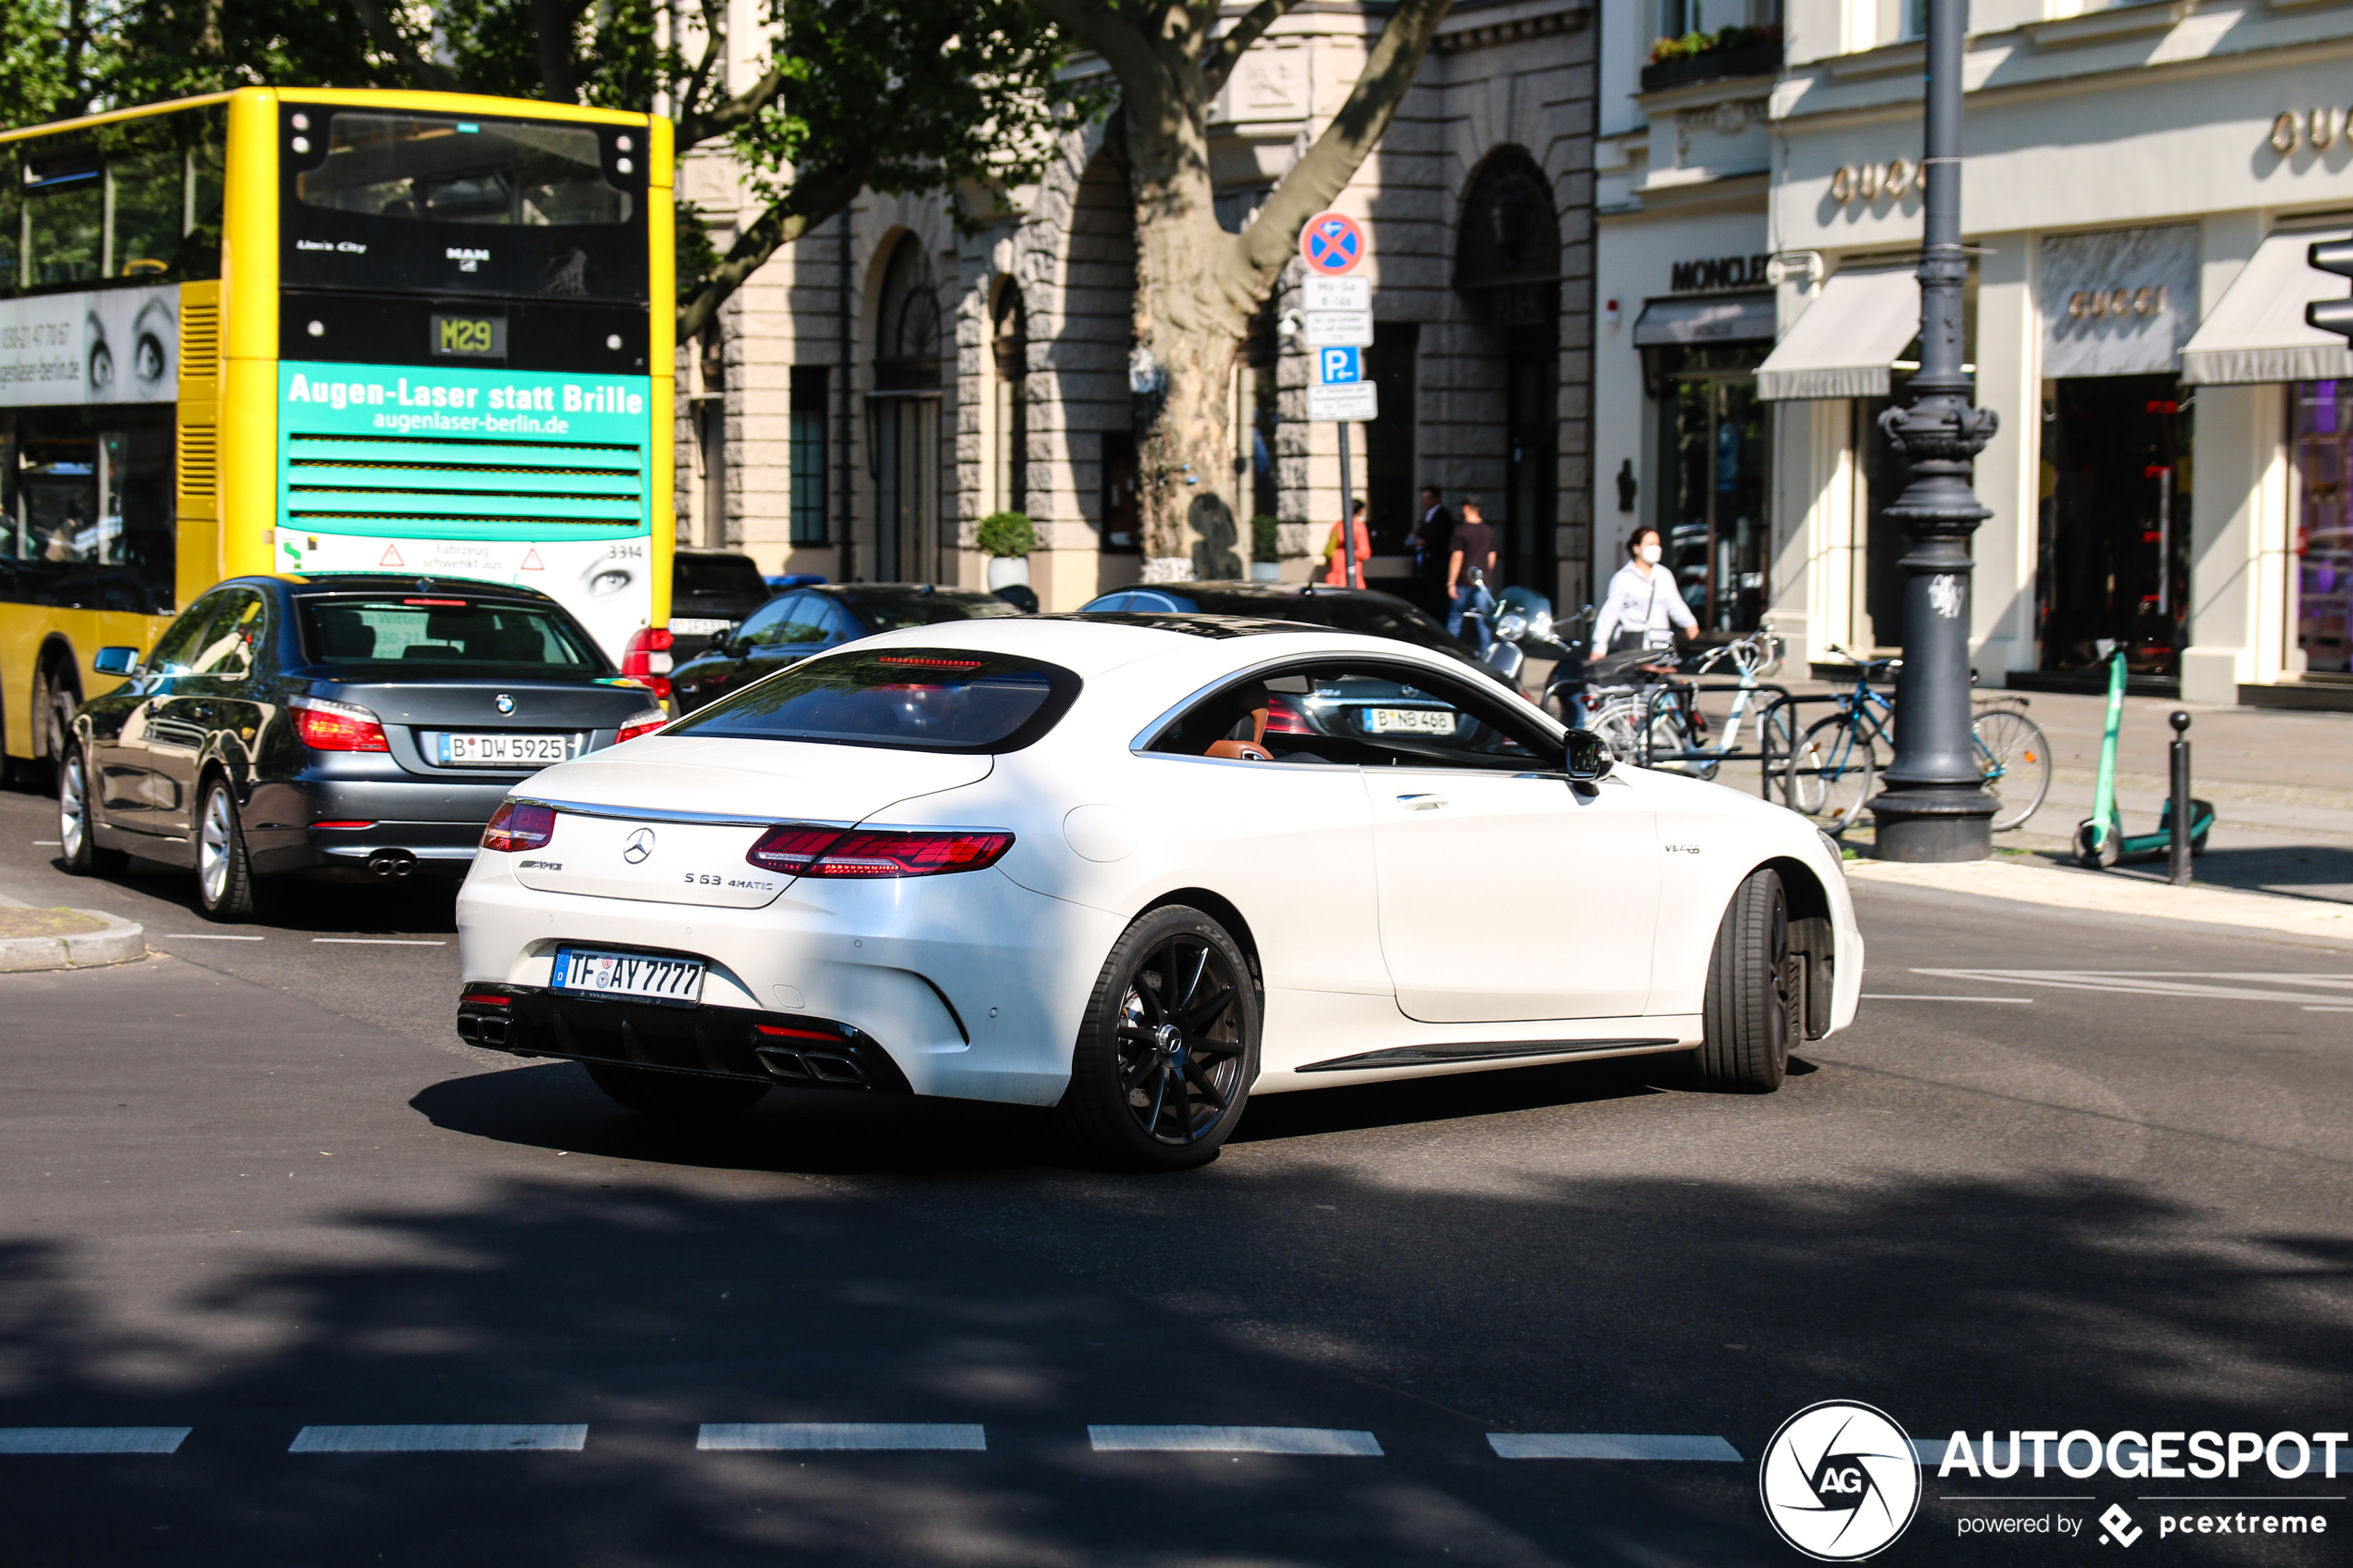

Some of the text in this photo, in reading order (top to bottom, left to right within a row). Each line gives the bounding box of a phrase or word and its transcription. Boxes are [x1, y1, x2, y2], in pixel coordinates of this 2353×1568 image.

[335, 241, 367, 255] City
[447, 247, 490, 261] MAN
[1671, 253, 1768, 293] MONCLE
[2069, 284, 2168, 319] GUCCI
[440, 319, 492, 352] M29
[1325, 349, 1349, 382] P
[288, 372, 644, 415] Augen-Laser statt Brille
[372, 410, 570, 434] augenlaser-berlin.de
[436, 543, 489, 558] Fahrzeug
[609, 545, 642, 559] 3314
[422, 557, 502, 570] schwenkt aus
[1378, 710, 1388, 727] B
[454, 737, 562, 759] B DW 5925
[684, 872, 774, 891] S 63 4MATIC
[572, 953, 700, 996] TF AY 7777
